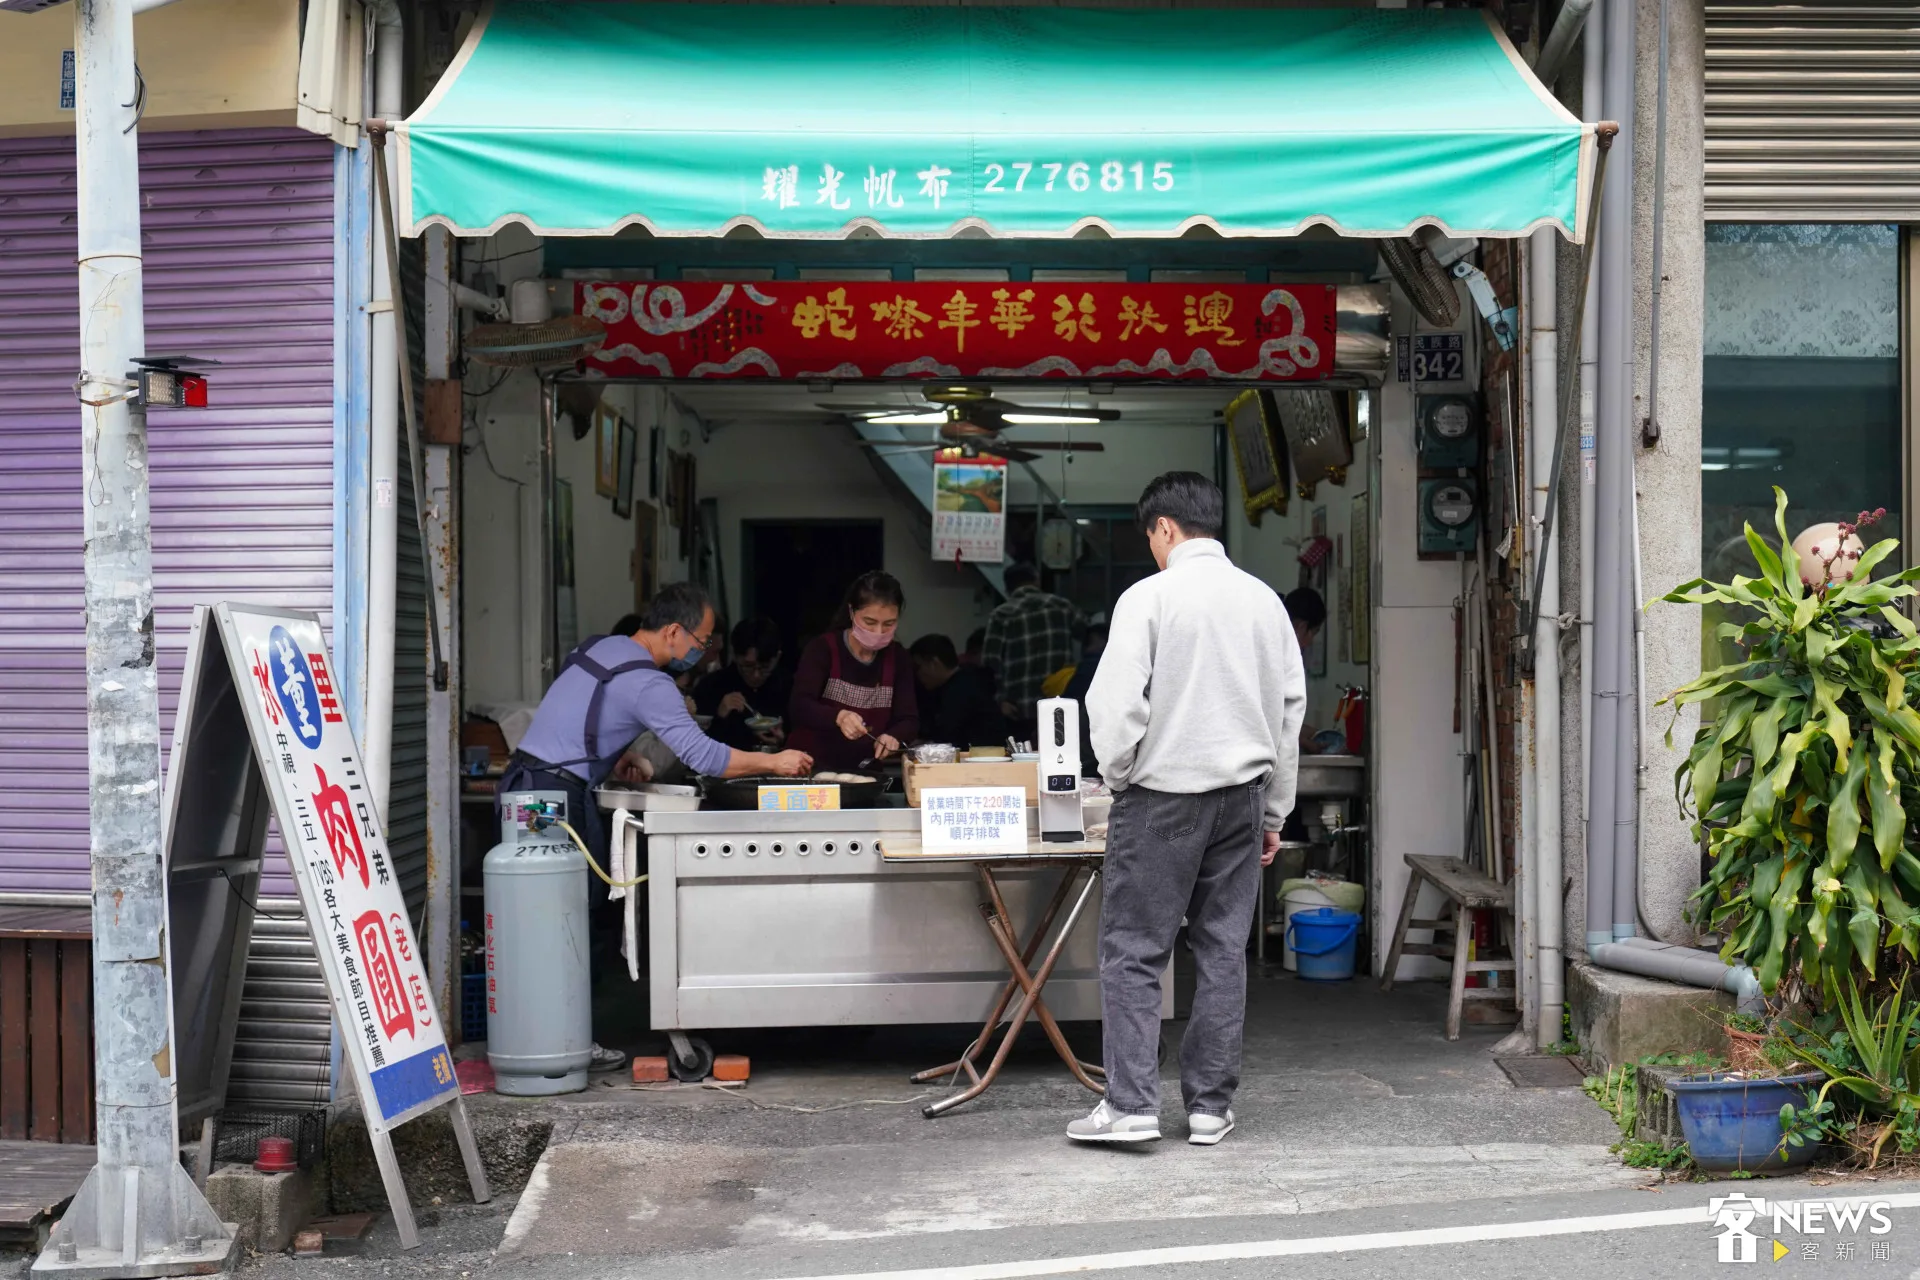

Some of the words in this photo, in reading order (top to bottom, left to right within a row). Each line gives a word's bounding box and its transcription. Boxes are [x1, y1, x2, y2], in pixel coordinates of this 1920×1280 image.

[760, 163, 953, 210] 耀光帆布
[984, 162, 1175, 192] 2776815
[1414, 352, 1462, 381] 342
[307, 653, 343, 722] 里
[927, 795, 1021, 810] 營業時間下午2:20開始
[930, 811, 1019, 826] 內用與外帶請依
[949, 827, 1001, 840] 順序排隊
[311, 762, 415, 1043] 肉圓
